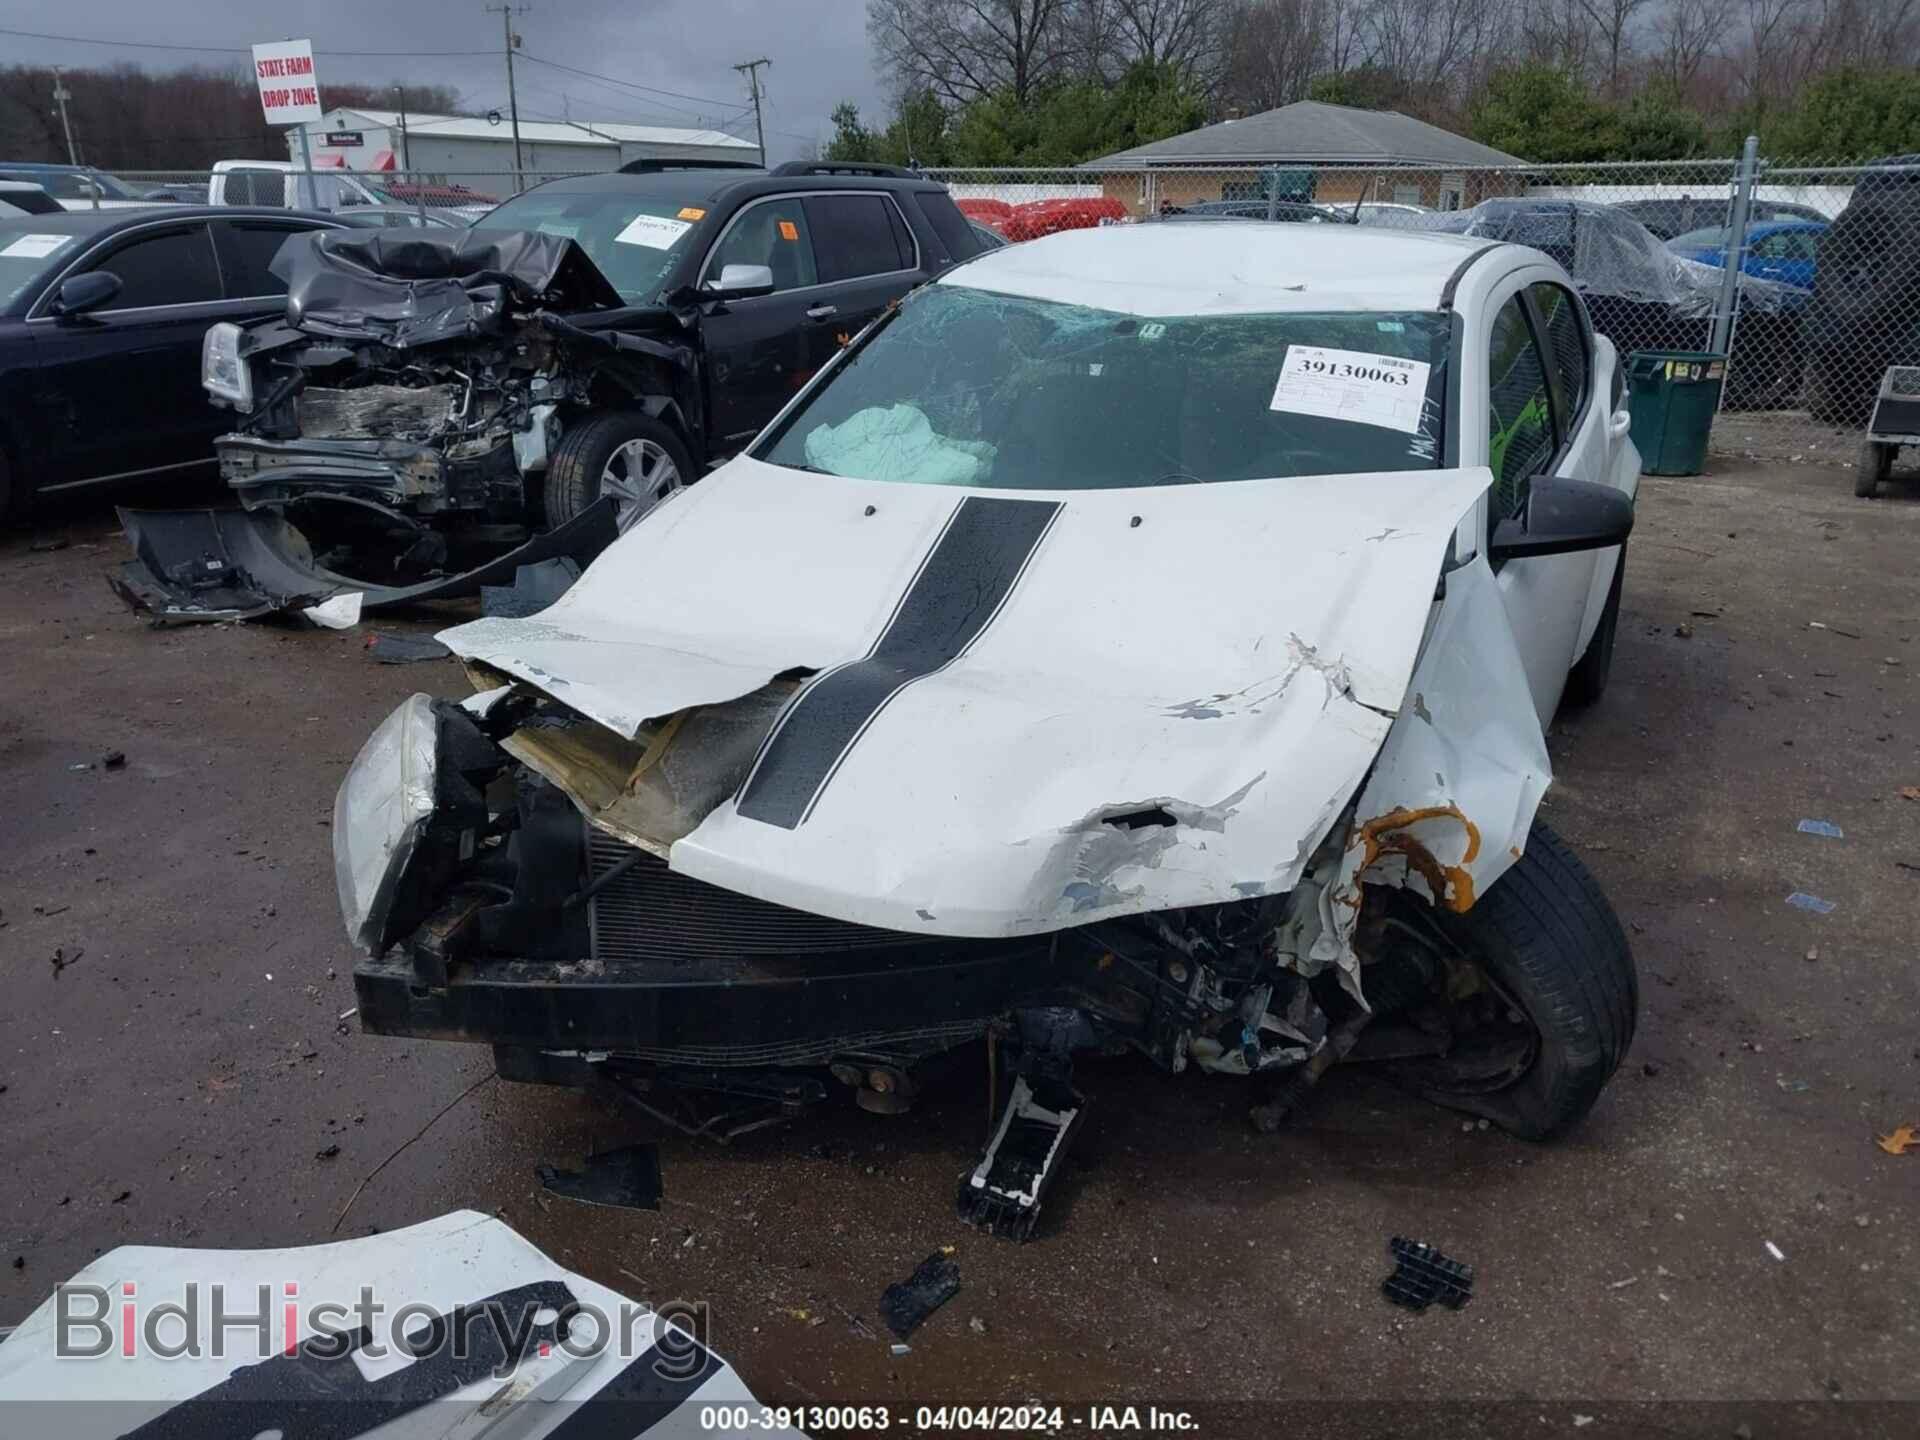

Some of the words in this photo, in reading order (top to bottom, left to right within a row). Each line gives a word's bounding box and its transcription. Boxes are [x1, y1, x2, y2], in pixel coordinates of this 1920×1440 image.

[257, 59, 285, 78] STATE
[286, 56, 312, 76] FARM
[263, 88, 290, 108] DROP
[291, 87, 317, 106] ZONE
[1297, 359, 1409, 386] 39130063
